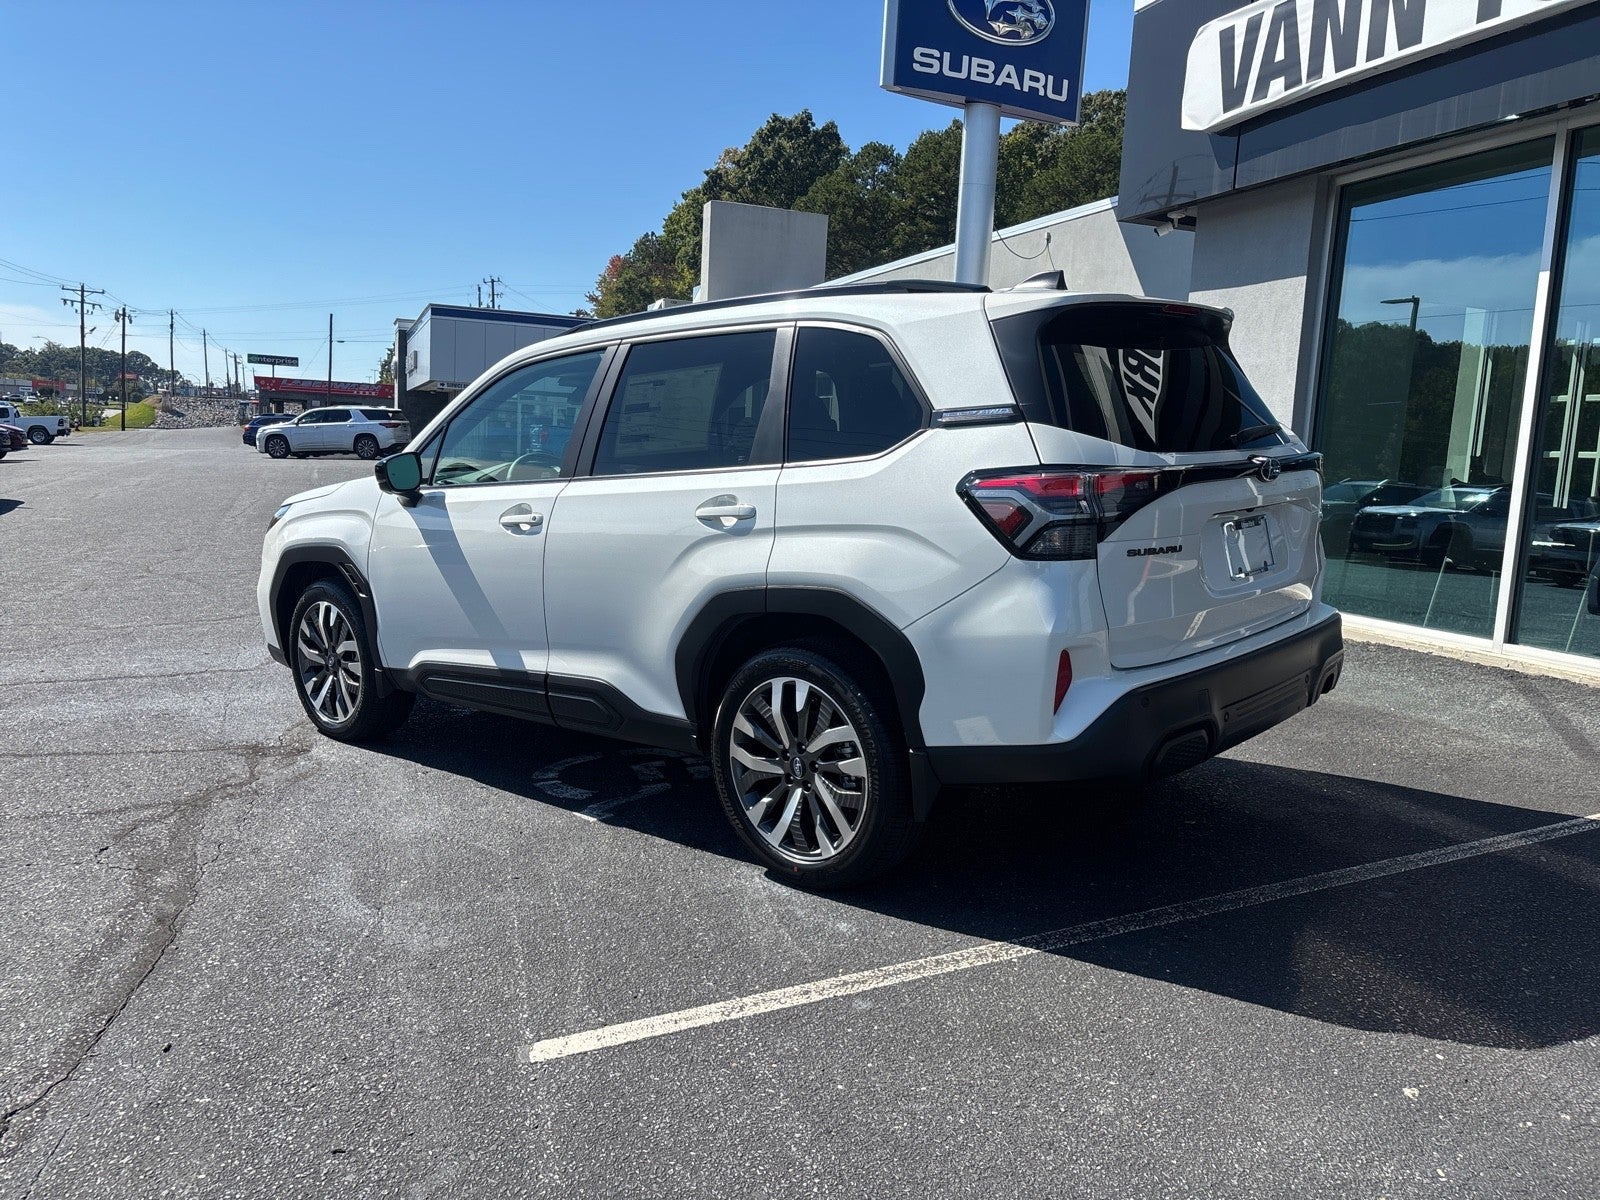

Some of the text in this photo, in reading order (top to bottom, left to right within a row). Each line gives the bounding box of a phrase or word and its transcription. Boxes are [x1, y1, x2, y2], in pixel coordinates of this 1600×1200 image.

[1219, 0, 1427, 115] VANN
[913, 47, 1068, 102] SUBARU
[249, 356, 298, 365] enterprise
[1127, 545, 1183, 557] SUBARU
